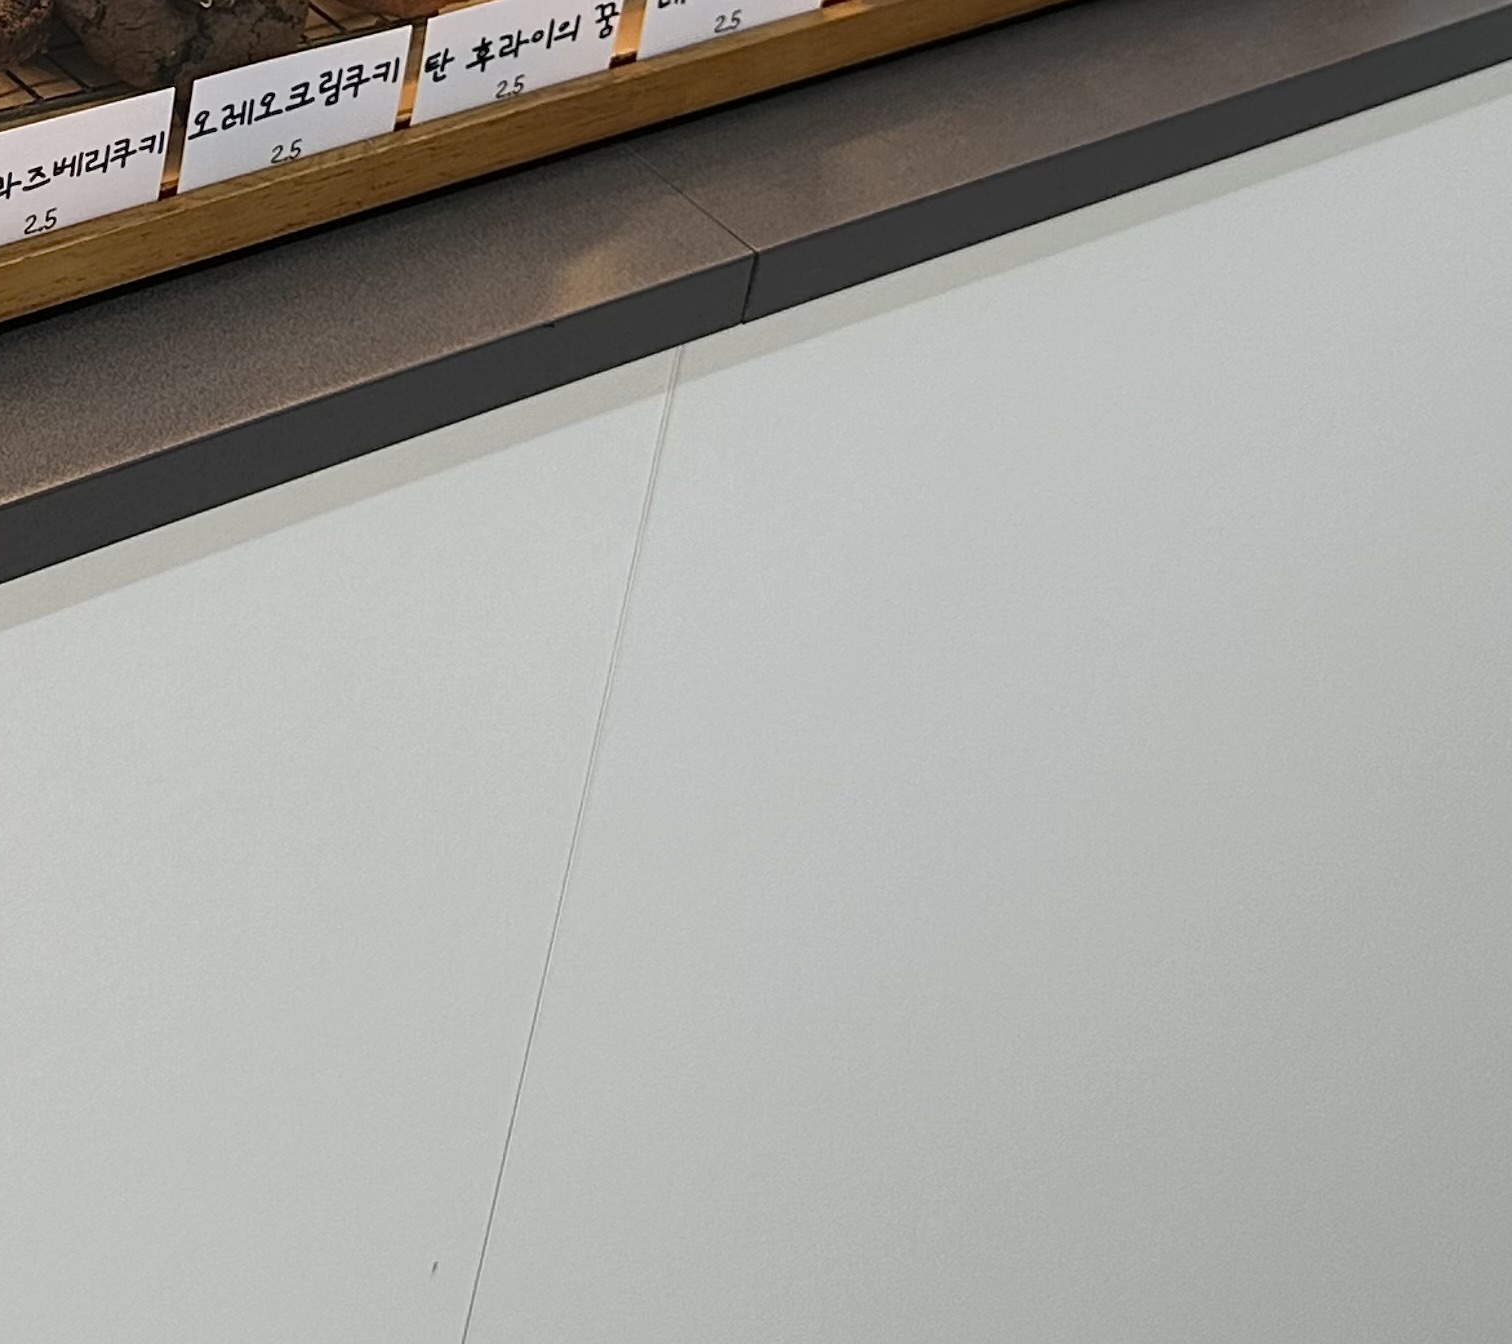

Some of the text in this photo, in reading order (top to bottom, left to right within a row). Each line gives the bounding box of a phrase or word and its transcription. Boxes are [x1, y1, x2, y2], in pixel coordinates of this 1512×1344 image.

[188, 57, 400, 140] 오레오크림쿠키
[495, 74, 526, 99] 2.5
[24, 207, 58, 235] 2.5
